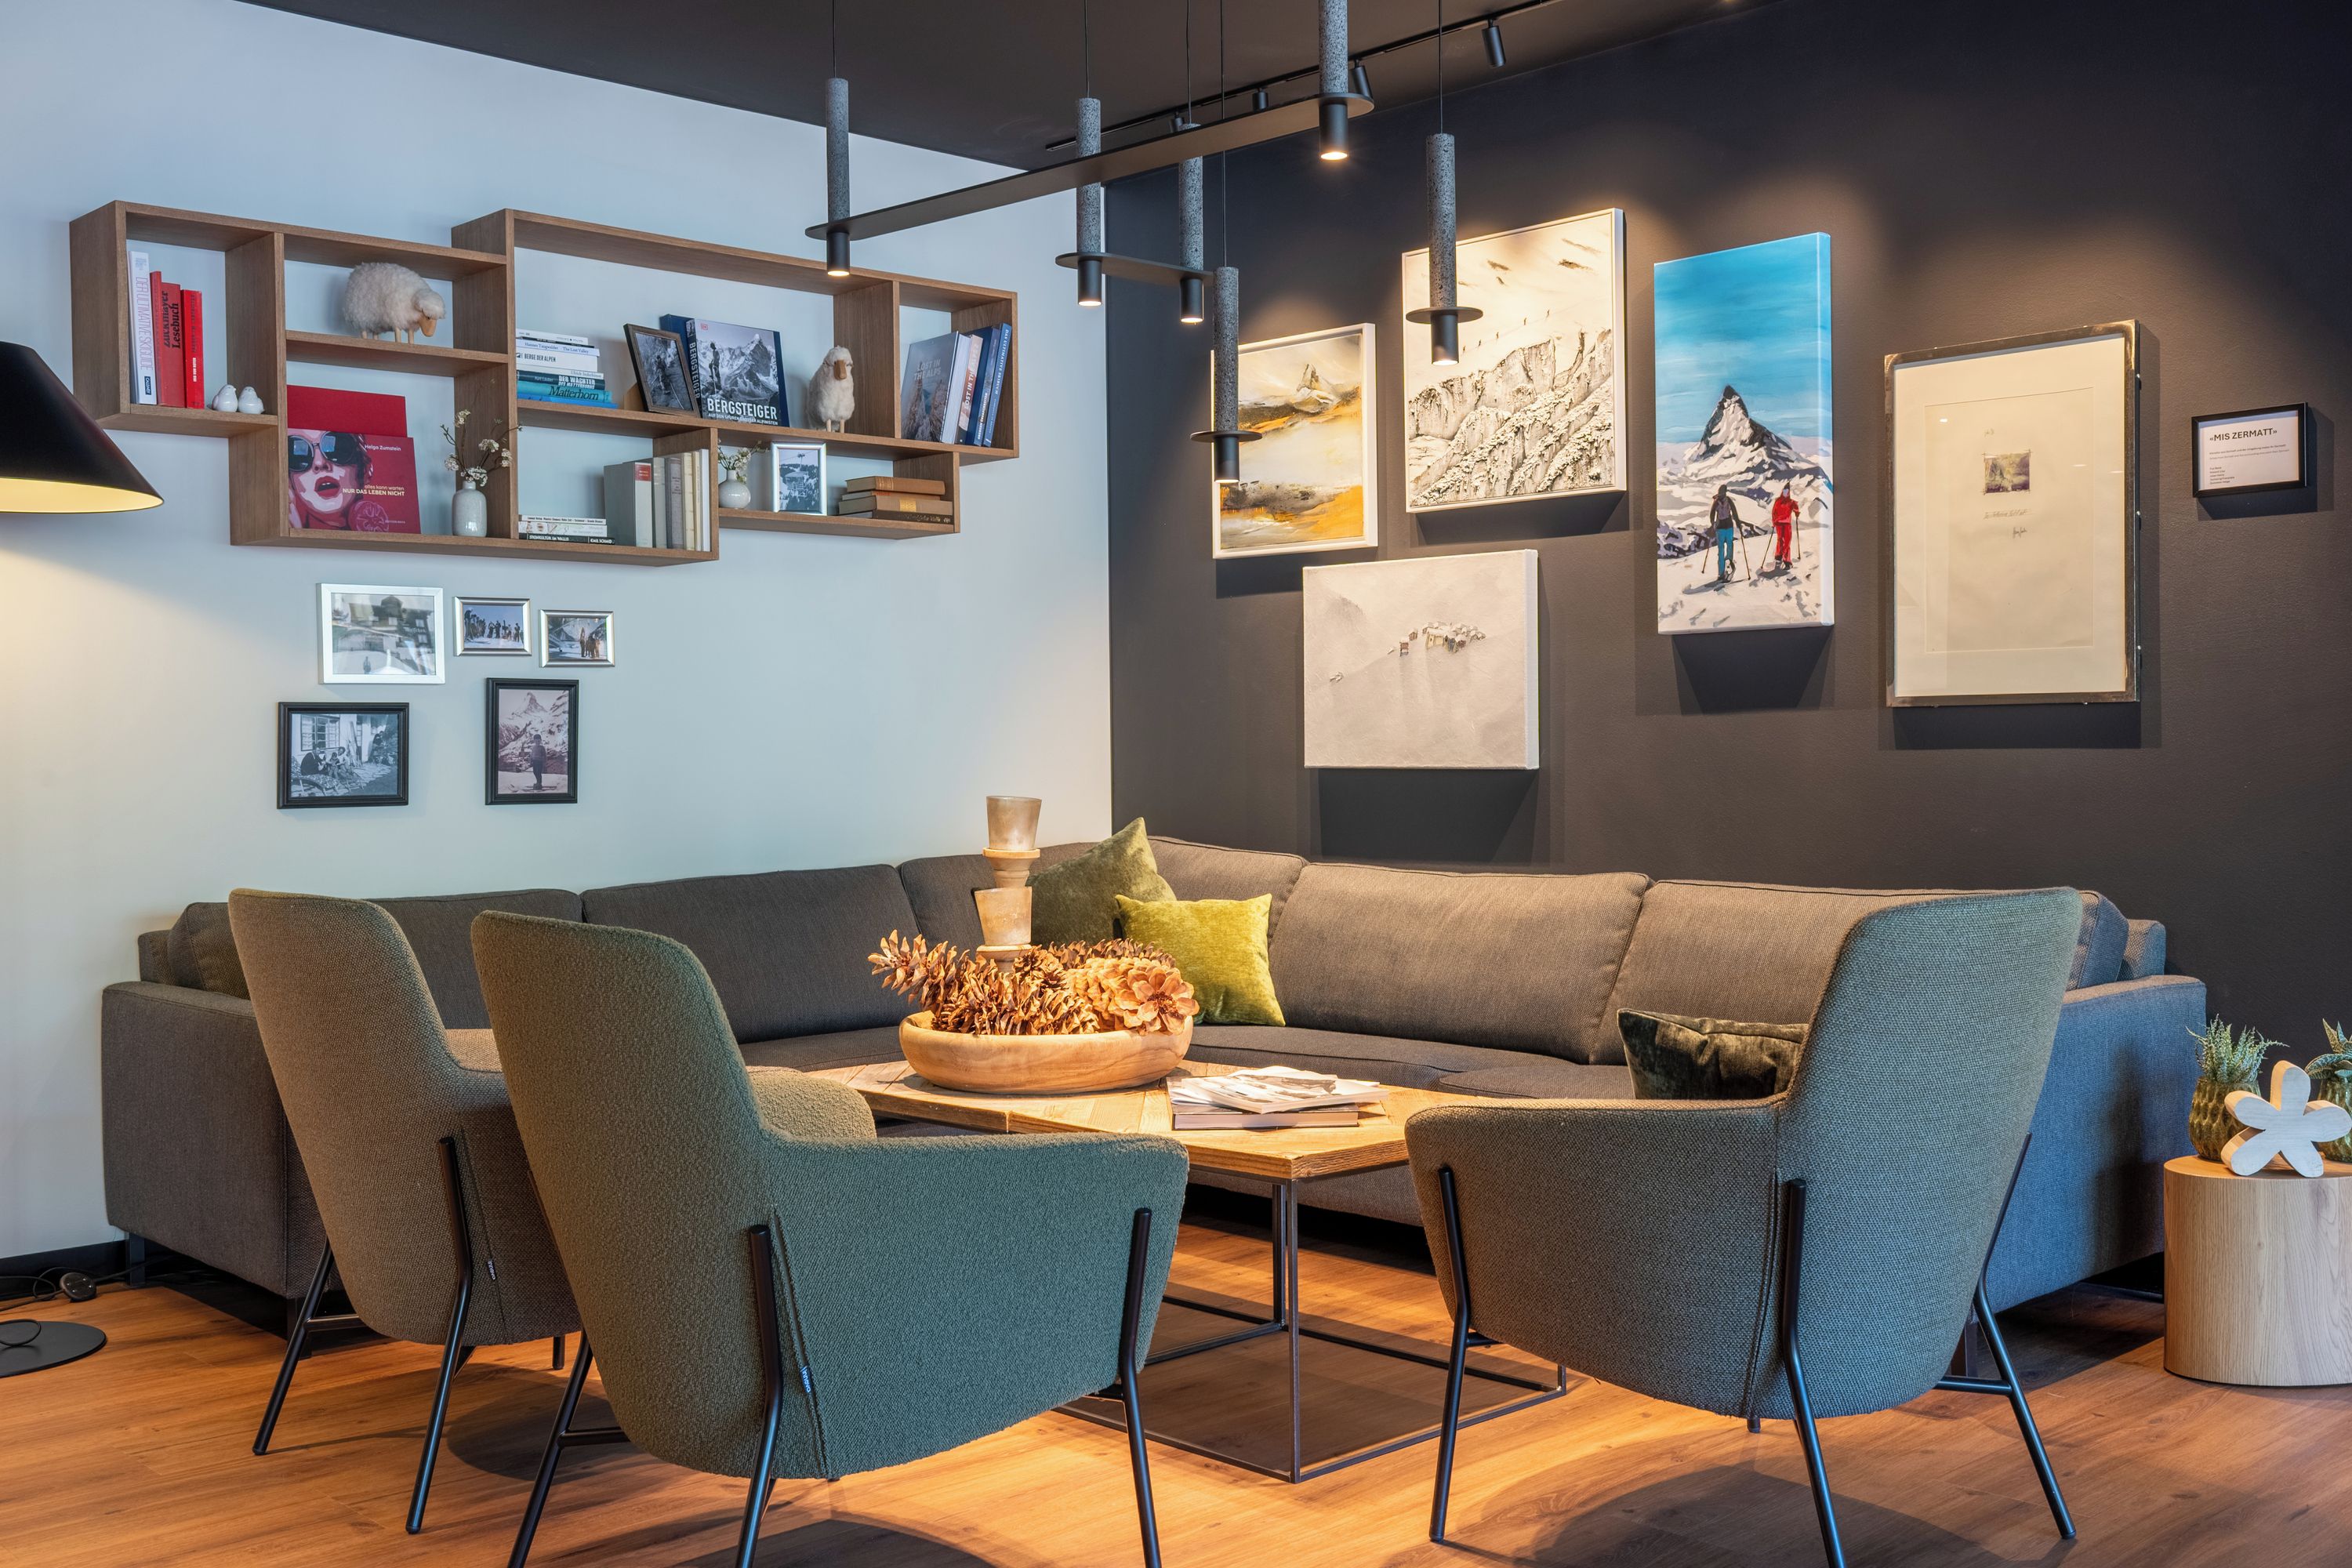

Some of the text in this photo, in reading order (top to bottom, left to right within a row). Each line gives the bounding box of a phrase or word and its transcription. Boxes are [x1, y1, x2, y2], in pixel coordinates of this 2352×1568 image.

[136, 293, 151, 336] ULTIMATIVE
[170, 303, 181, 349] Lesebuch
[999, 339, 1008, 371] ULTIMATIVE
[689, 342, 701, 399] BERGSTEIGER
[914, 368, 942, 380] THE ALPS
[917, 359, 941, 371] LOST IN
[549, 386, 599, 401] Matterhorn
[967, 382, 973, 391] IN
[707, 398, 778, 420] BERGSTEIGER
[2209, 428, 2278, 441] «MIS ZERMATT»
